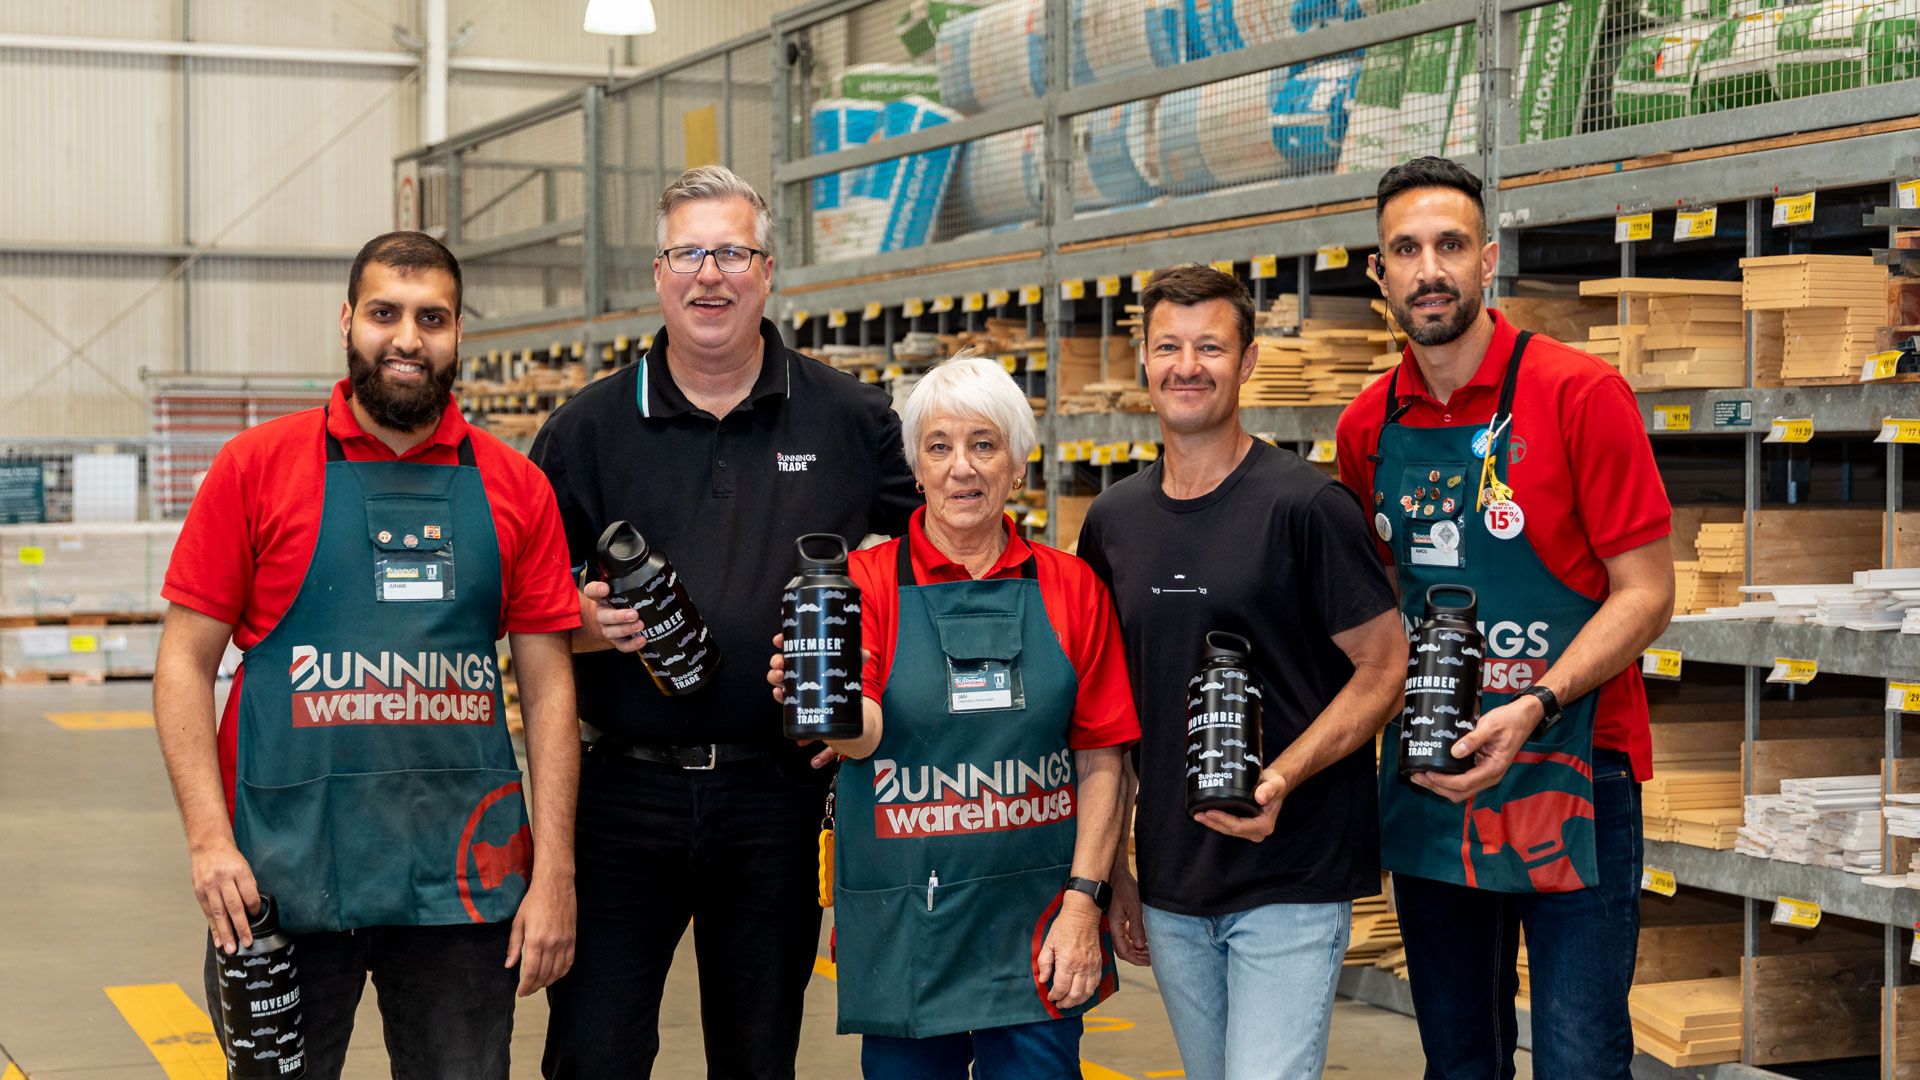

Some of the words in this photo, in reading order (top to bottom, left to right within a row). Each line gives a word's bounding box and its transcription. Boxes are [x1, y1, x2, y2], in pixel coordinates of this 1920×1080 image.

[776, 452, 817, 462] BUNNINGS
[777, 461, 808, 472] TRADE
[1488, 510, 1520, 530] 15%
[289, 645, 496, 692] BUNNINGS
[674, 673, 701, 690] TRADE
[303, 679, 491, 723] warehouse
[797, 706, 834, 715] BUNNINGS
[797, 714, 825, 725] TRADE
[1408, 739, 1442, 749] BUNNINGS
[1408, 747, 1433, 757] TRADE
[873, 748, 1071, 803] BUNNINGS
[1198, 772, 1233, 781] BUNNINGS
[1198, 778, 1224, 790] TRADE
[885, 789, 1071, 834] warehouse
[279, 1058, 302, 1074] TRADE
